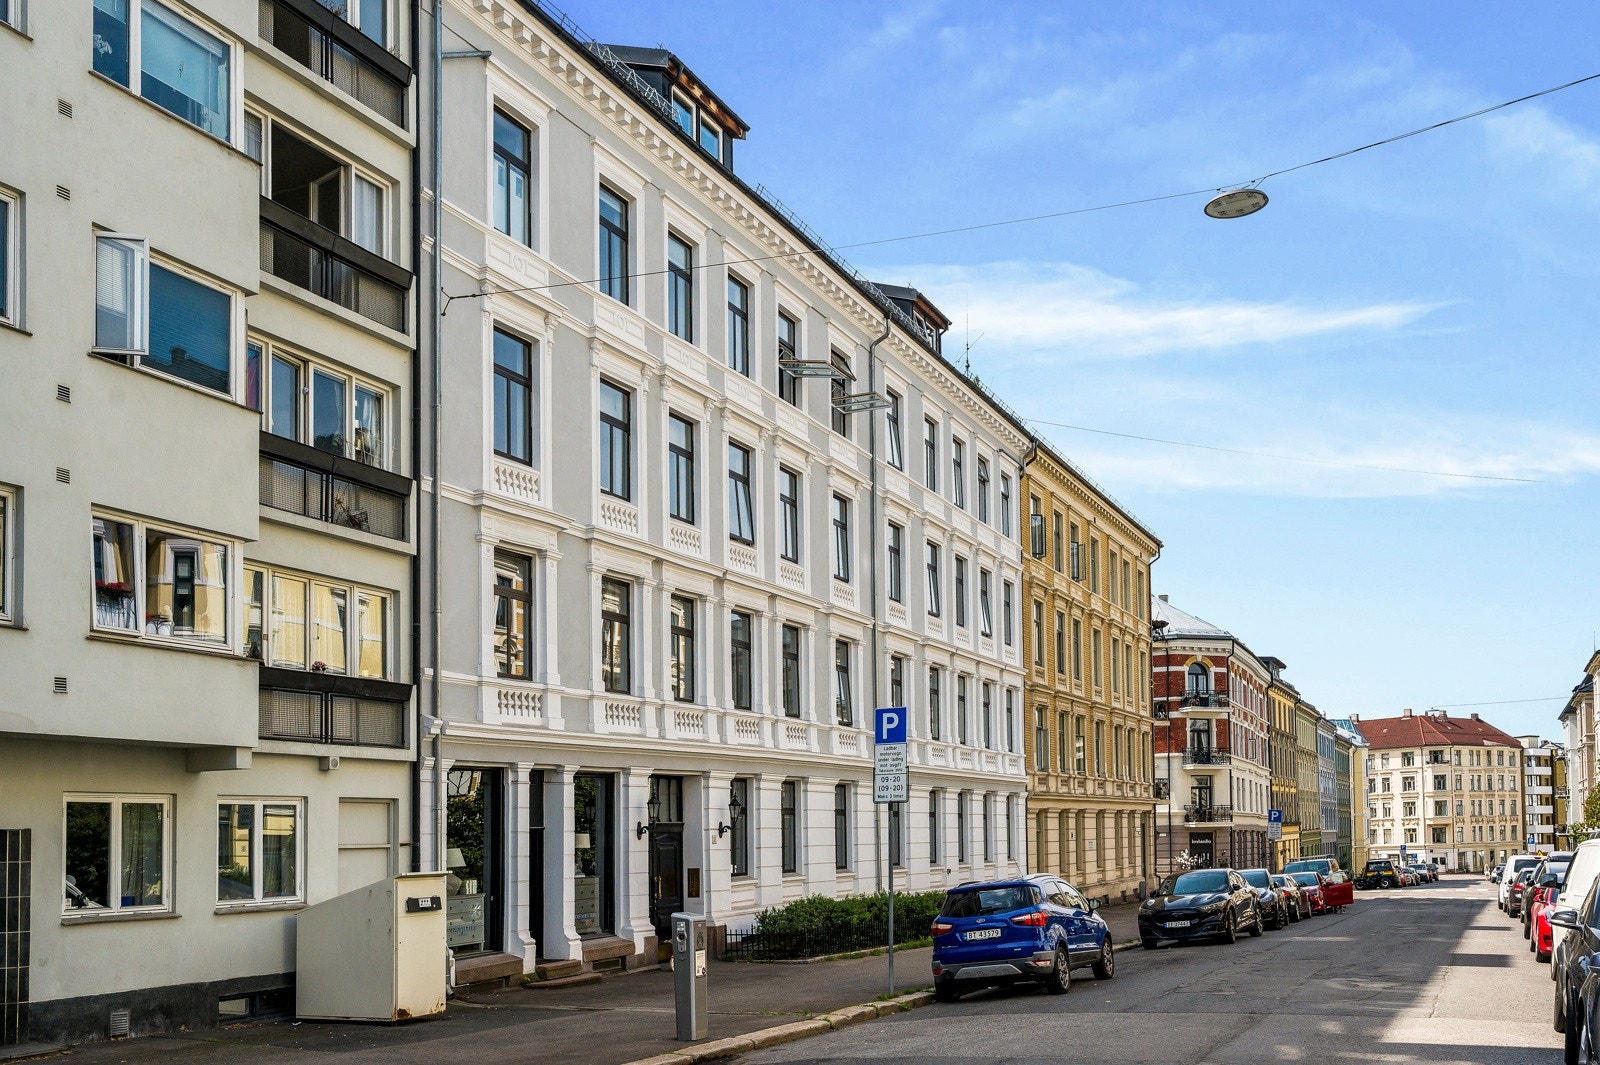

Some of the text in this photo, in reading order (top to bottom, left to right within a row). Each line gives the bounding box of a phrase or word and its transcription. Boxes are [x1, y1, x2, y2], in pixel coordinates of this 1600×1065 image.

[882, 712, 899, 740] P
[1272, 811, 1279, 820] P
[979, 929, 999, 938] 43579
